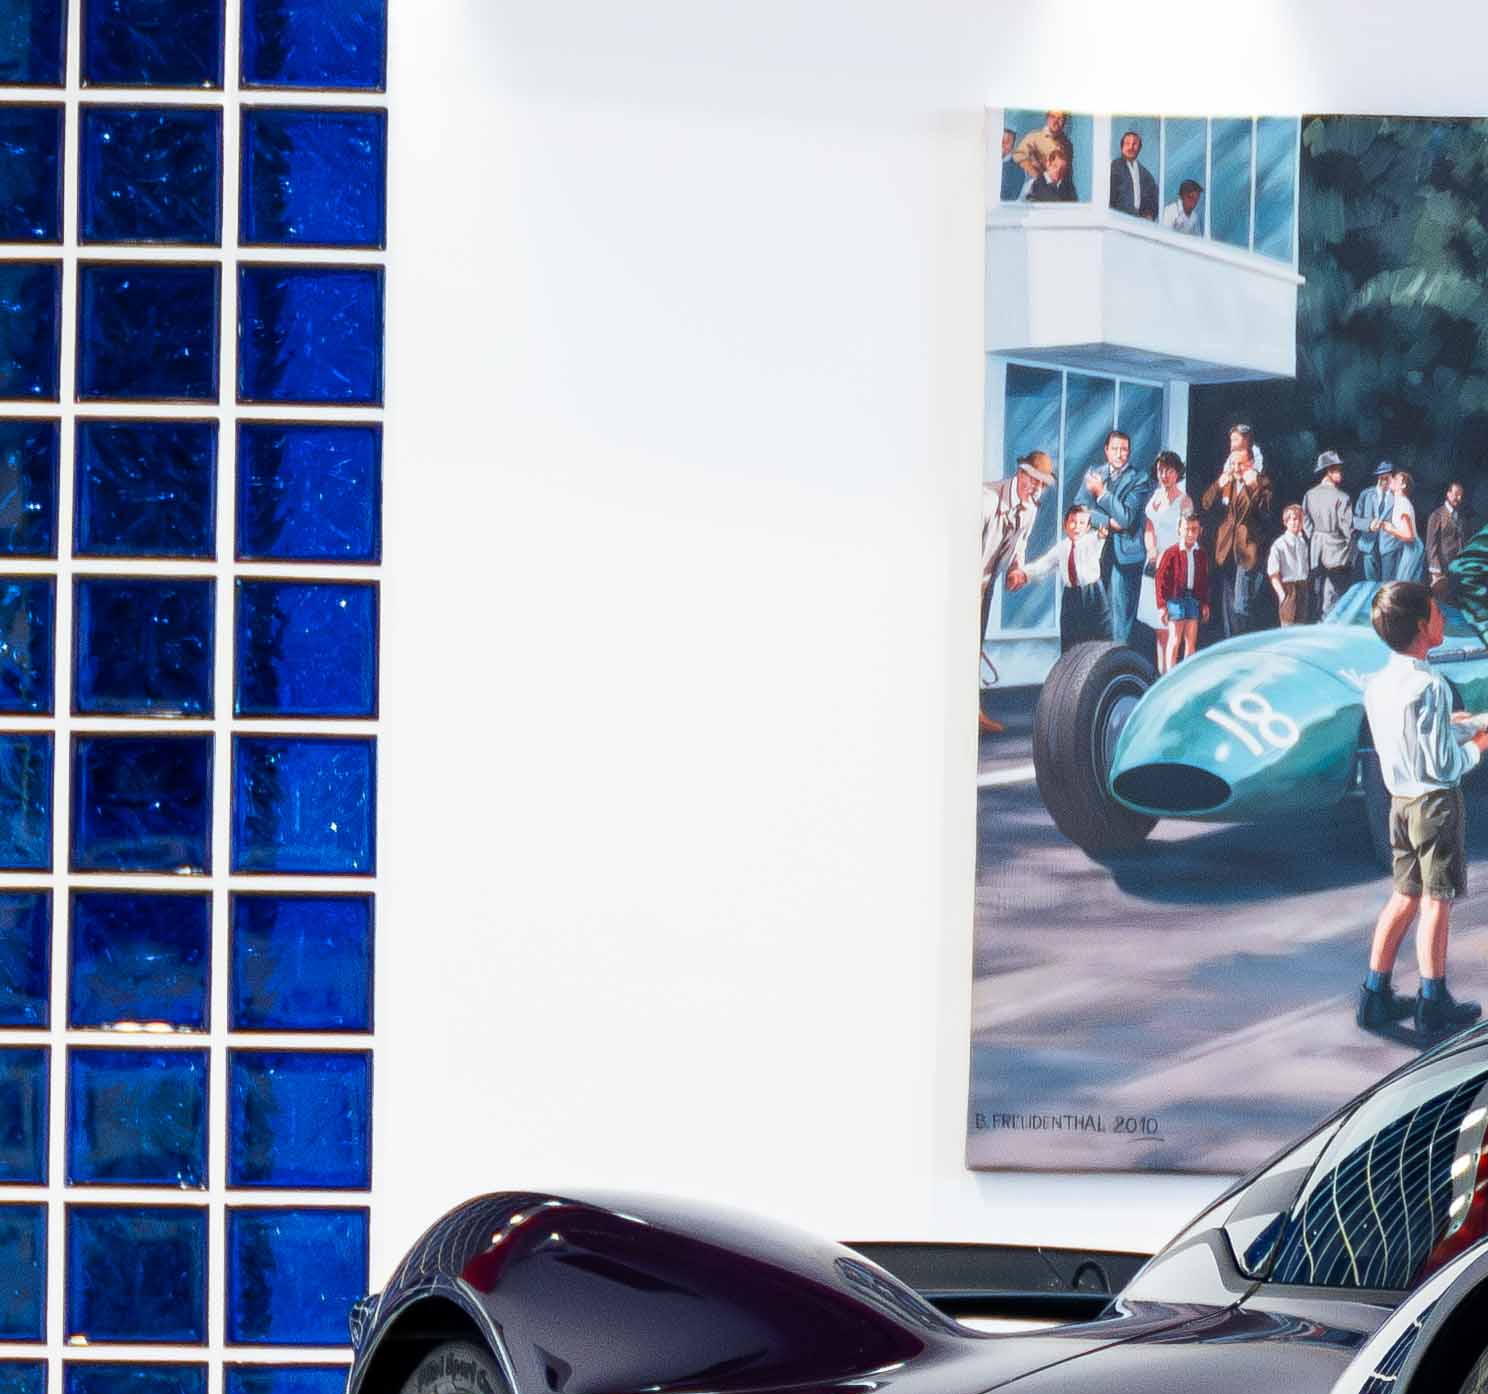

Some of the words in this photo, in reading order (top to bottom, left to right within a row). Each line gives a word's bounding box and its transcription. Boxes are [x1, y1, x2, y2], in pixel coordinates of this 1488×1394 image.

[1205, 691, 1300, 757] 18
[992, 1112, 1106, 1133] FREUDENTHAL
[1113, 1116, 1158, 1134] 2010
